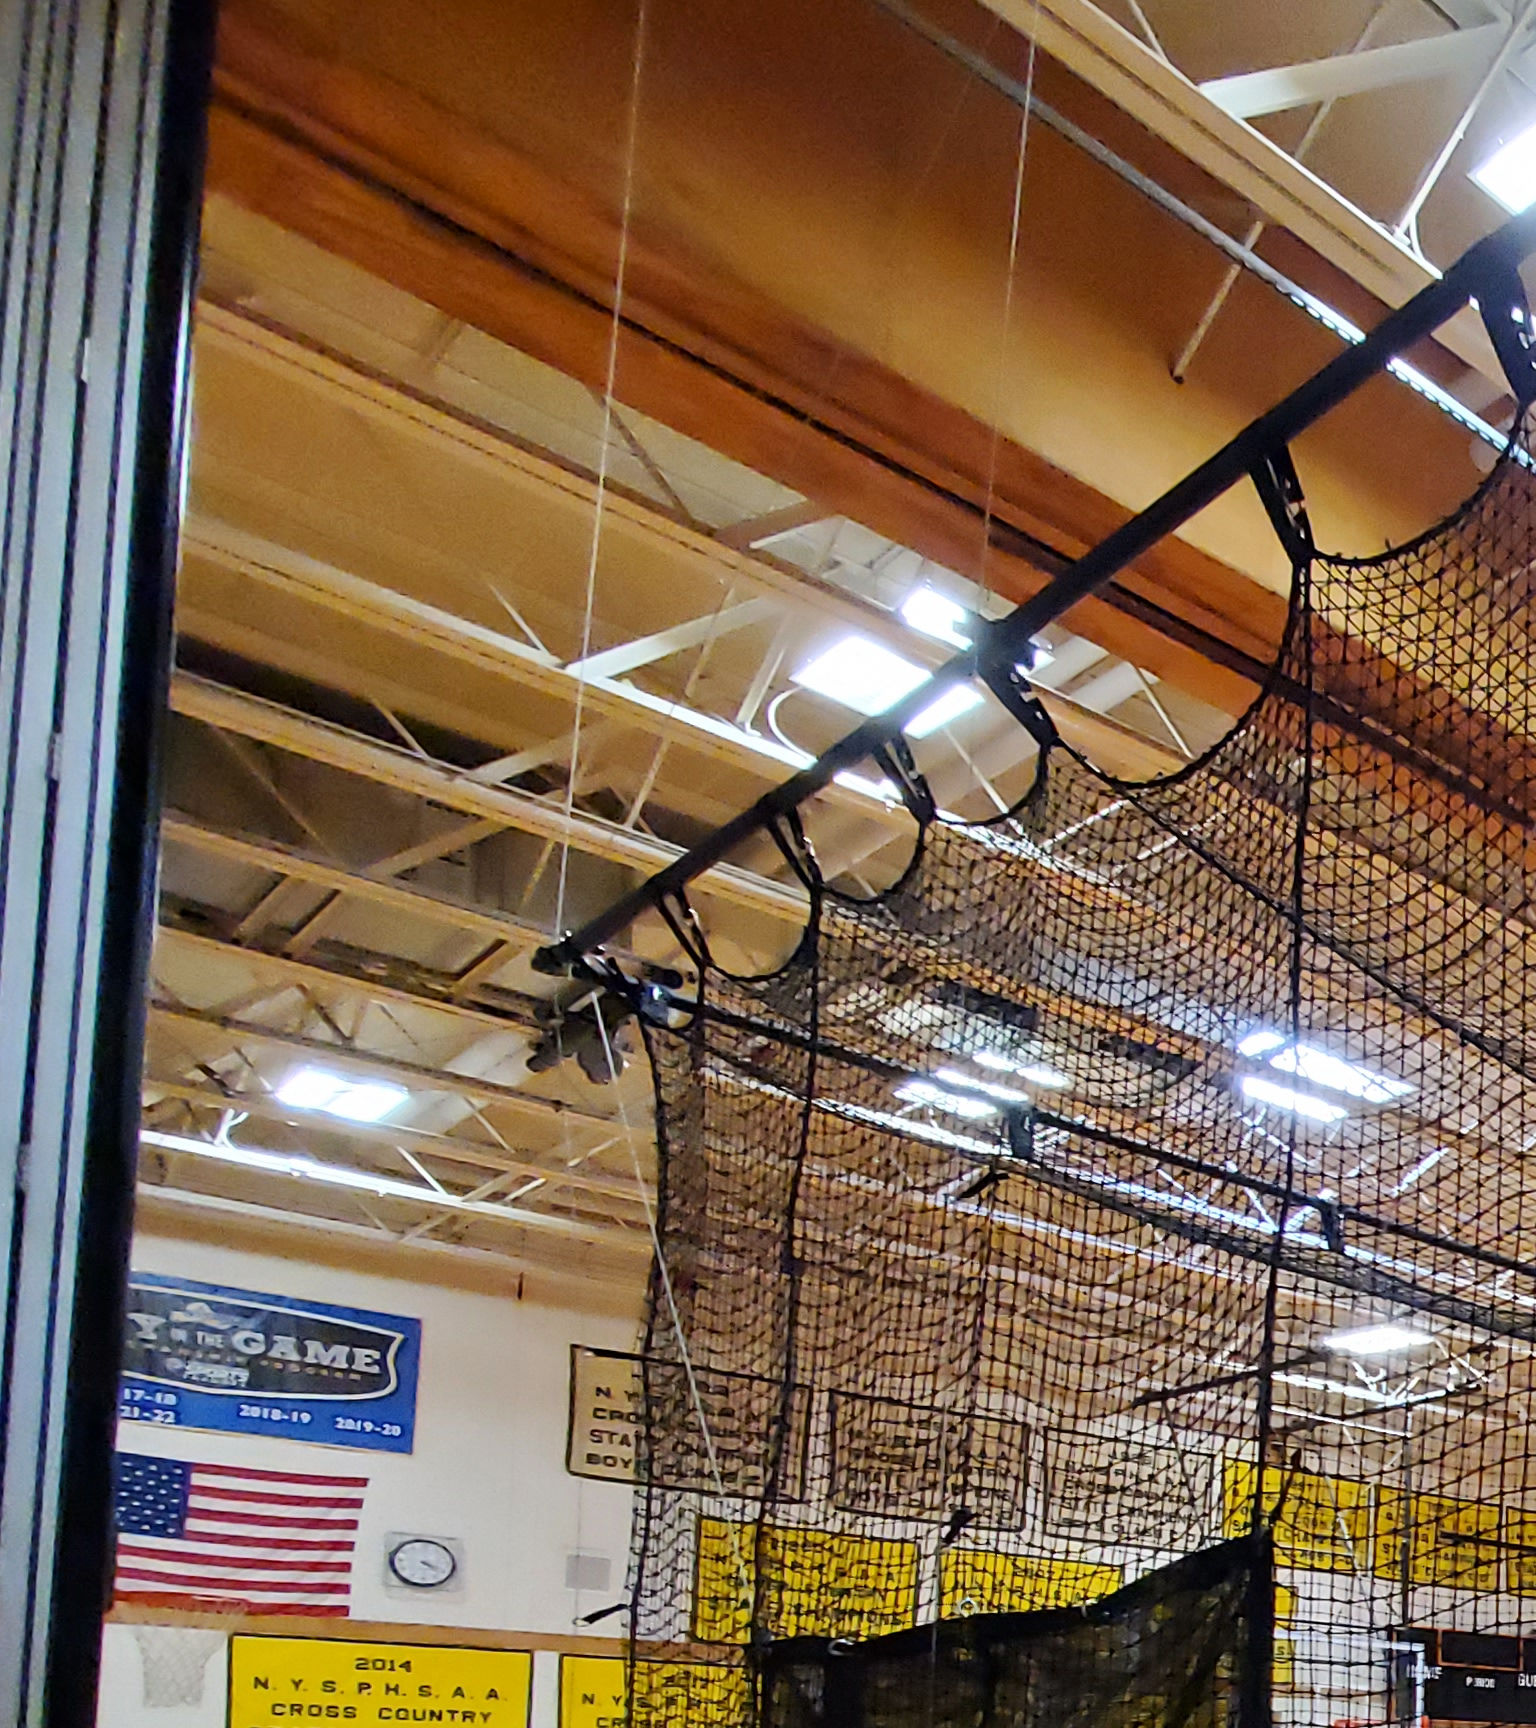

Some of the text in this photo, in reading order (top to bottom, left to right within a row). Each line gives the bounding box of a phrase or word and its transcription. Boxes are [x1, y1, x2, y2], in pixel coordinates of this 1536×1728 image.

[230, 1330, 382, 1374] GAME
[334, 1416, 402, 1438] 2019-20
[354, 1657, 413, 1673] 2014
[270, 1702, 493, 1724] CROSS COUNTRY
